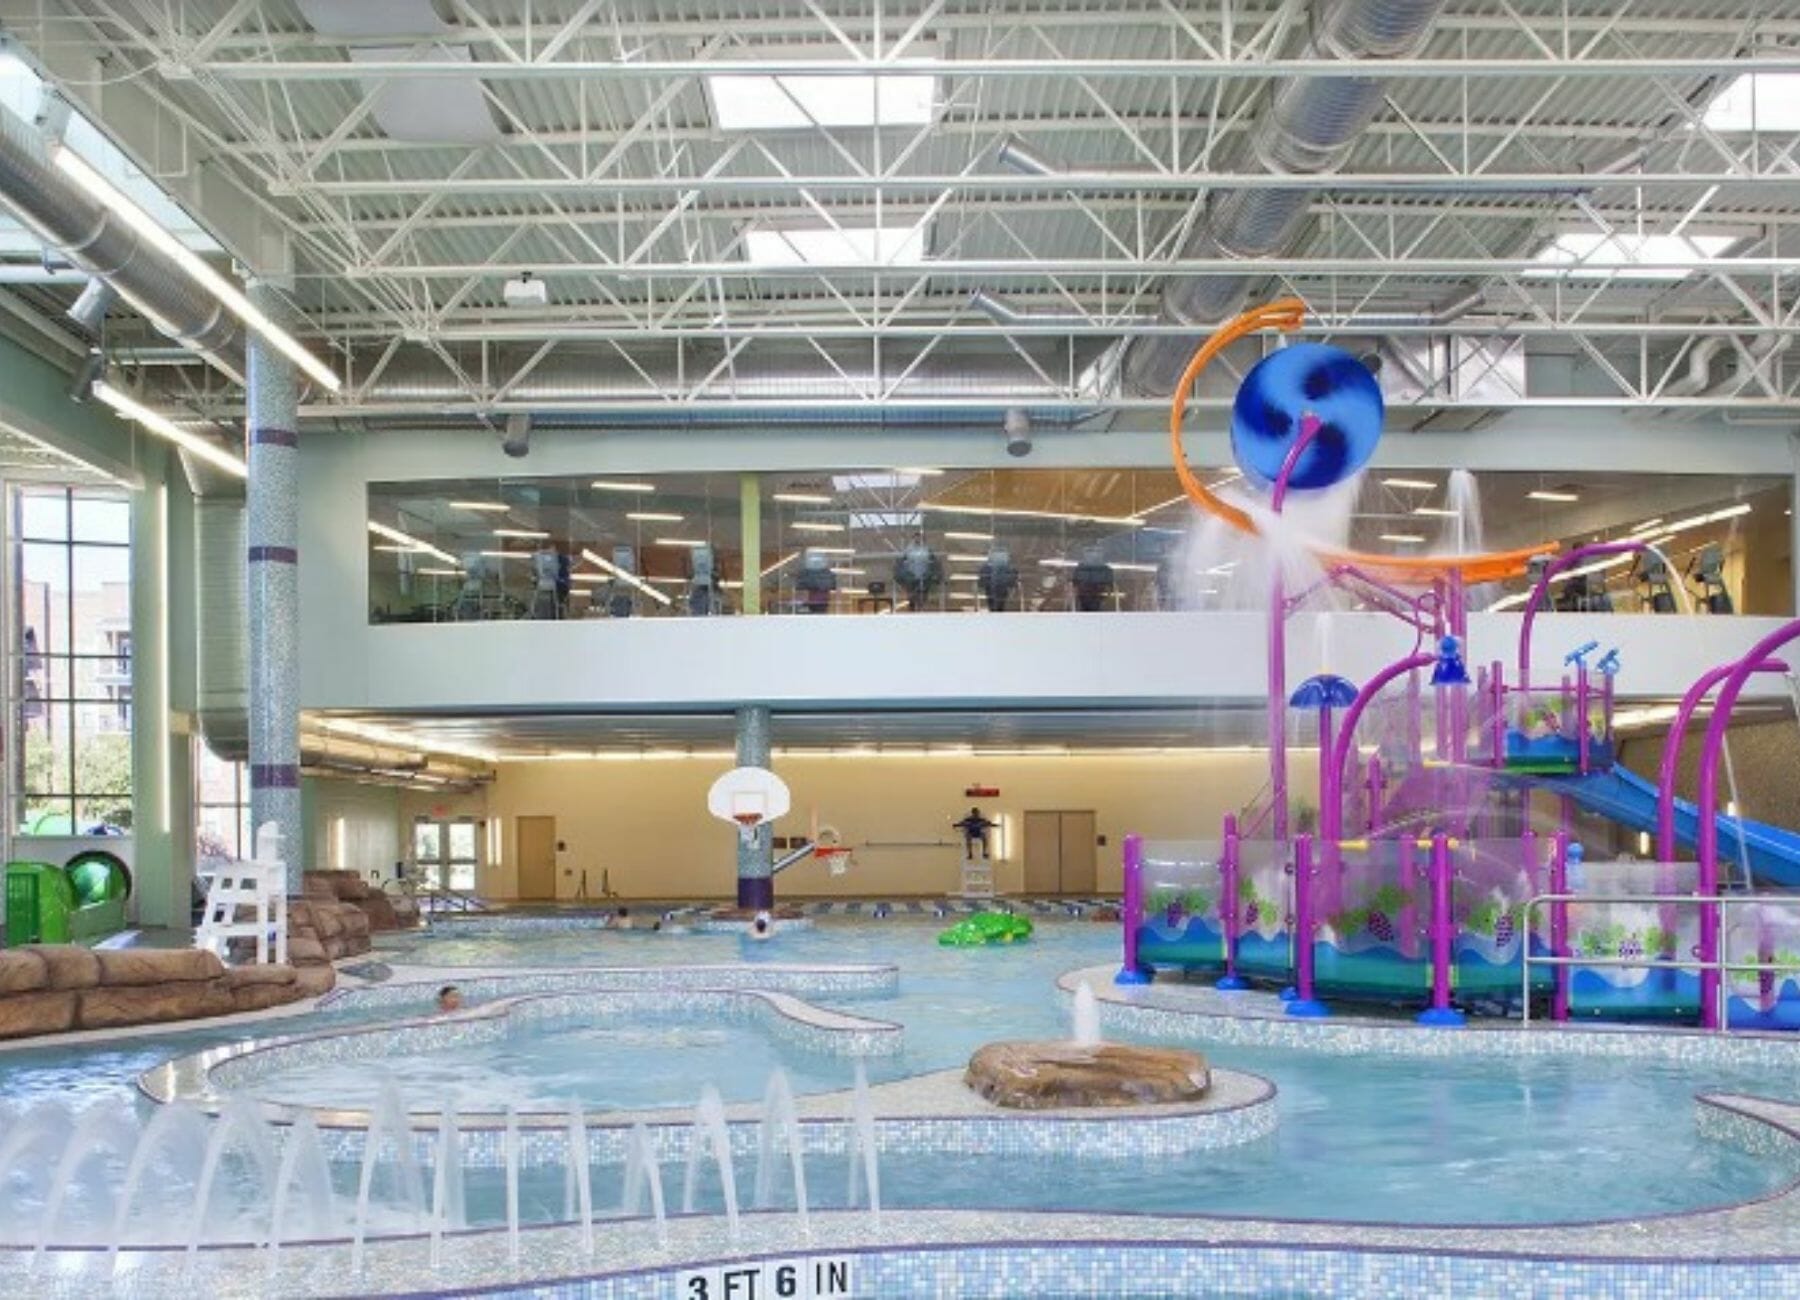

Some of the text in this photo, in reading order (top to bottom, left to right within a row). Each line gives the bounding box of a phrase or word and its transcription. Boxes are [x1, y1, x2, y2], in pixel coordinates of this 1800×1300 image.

[688, 1261, 847, 1300] 3 FT 6 IN
